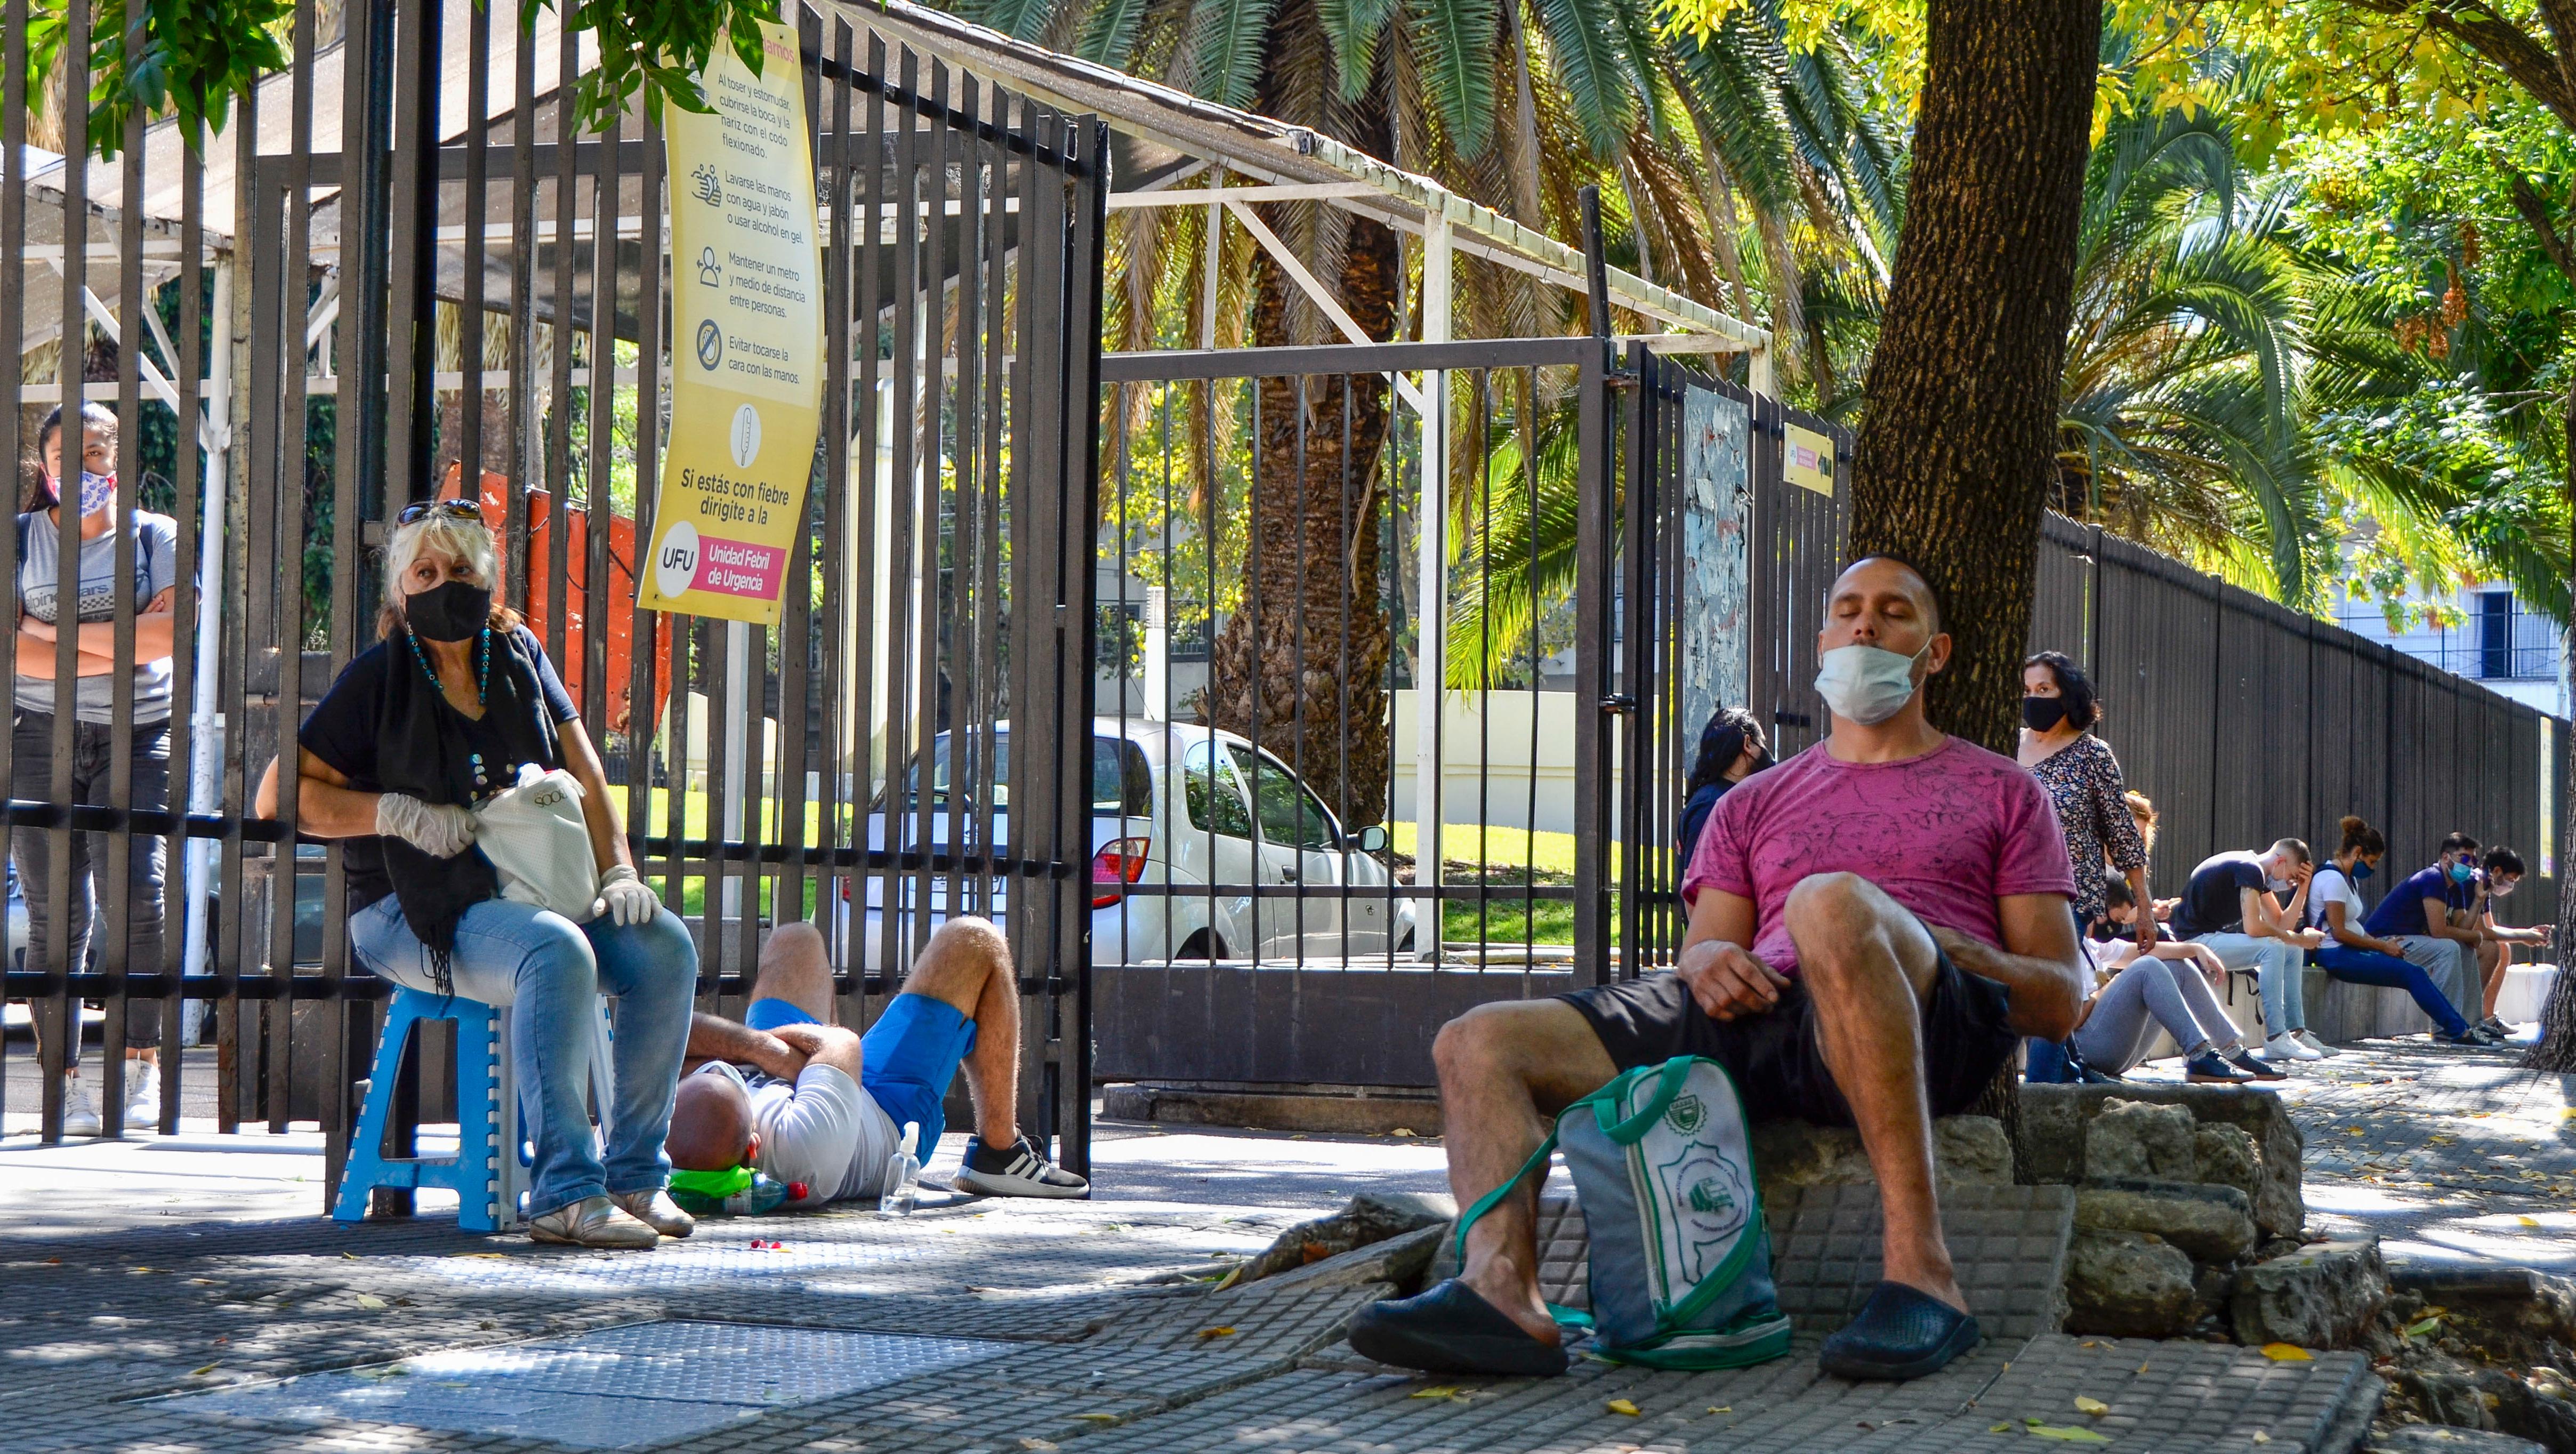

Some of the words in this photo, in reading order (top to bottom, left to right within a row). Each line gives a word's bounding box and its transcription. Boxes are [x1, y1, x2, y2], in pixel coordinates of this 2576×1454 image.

[719, 74, 726, 86] Al
[728, 77, 746, 93] toser
[747, 86, 752, 98] y
[754, 88, 791, 113] estornudar,
[720, 95, 749, 114] cubrirse
[751, 103, 757, 116] la
[759, 107, 776, 123] boca
[777, 116, 782, 128] y
[784, 116, 790, 128] la
[721, 116, 741, 131] nariz
[744, 124, 758, 136] con
[760, 127, 767, 139] el
[769, 133, 787, 146] codo
[723, 133, 767, 158] flexionado.
[726, 170, 754, 190] Lavarse
[756, 179, 766, 194] las
[768, 186, 791, 202] manos
[727, 193, 740, 205] con
[743, 198, 761, 211] agua
[763, 204, 767, 215] y
[769, 202, 789, 220] jabón
[728, 214, 732, 223] o
[735, 216, 750, 228] usar
[752, 219, 779, 236] alcohol
[780, 229, 790, 239] en
[791, 231, 804, 244] gel.
[729, 252, 764, 272] Mantener
[767, 264, 776, 275] un
[778, 267, 799, 282] metro
[729, 275, 734, 286] y
[736, 276, 760, 291] medio
[762, 281, 771, 294] de
[774, 284, 806, 302] distancia
[730, 295, 750, 308] entre
[752, 301, 787, 318] personas.
[729, 336, 751, 352] Evitar
[753, 342, 780, 359] tocarse
[782, 348, 788, 361] la
[729, 359, 745, 372] cara
[747, 363, 760, 375] con
[762, 364, 772, 378] las
[774, 369, 800, 384] manos.
[681, 468, 694, 488] Si
[697, 473, 729, 495] estás
[733, 481, 754, 499] con
[758, 481, 789, 505] fiebre
[701, 495, 745, 522] dirigite
[748, 508, 754, 523] a
[758, 505, 768, 525] la
[663, 547, 694, 571] UFU
[709, 544, 745, 566] Unidad
[744, 550, 770, 569] Febril
[708, 567, 722, 585] de
[723, 569, 763, 591] Urgencia
